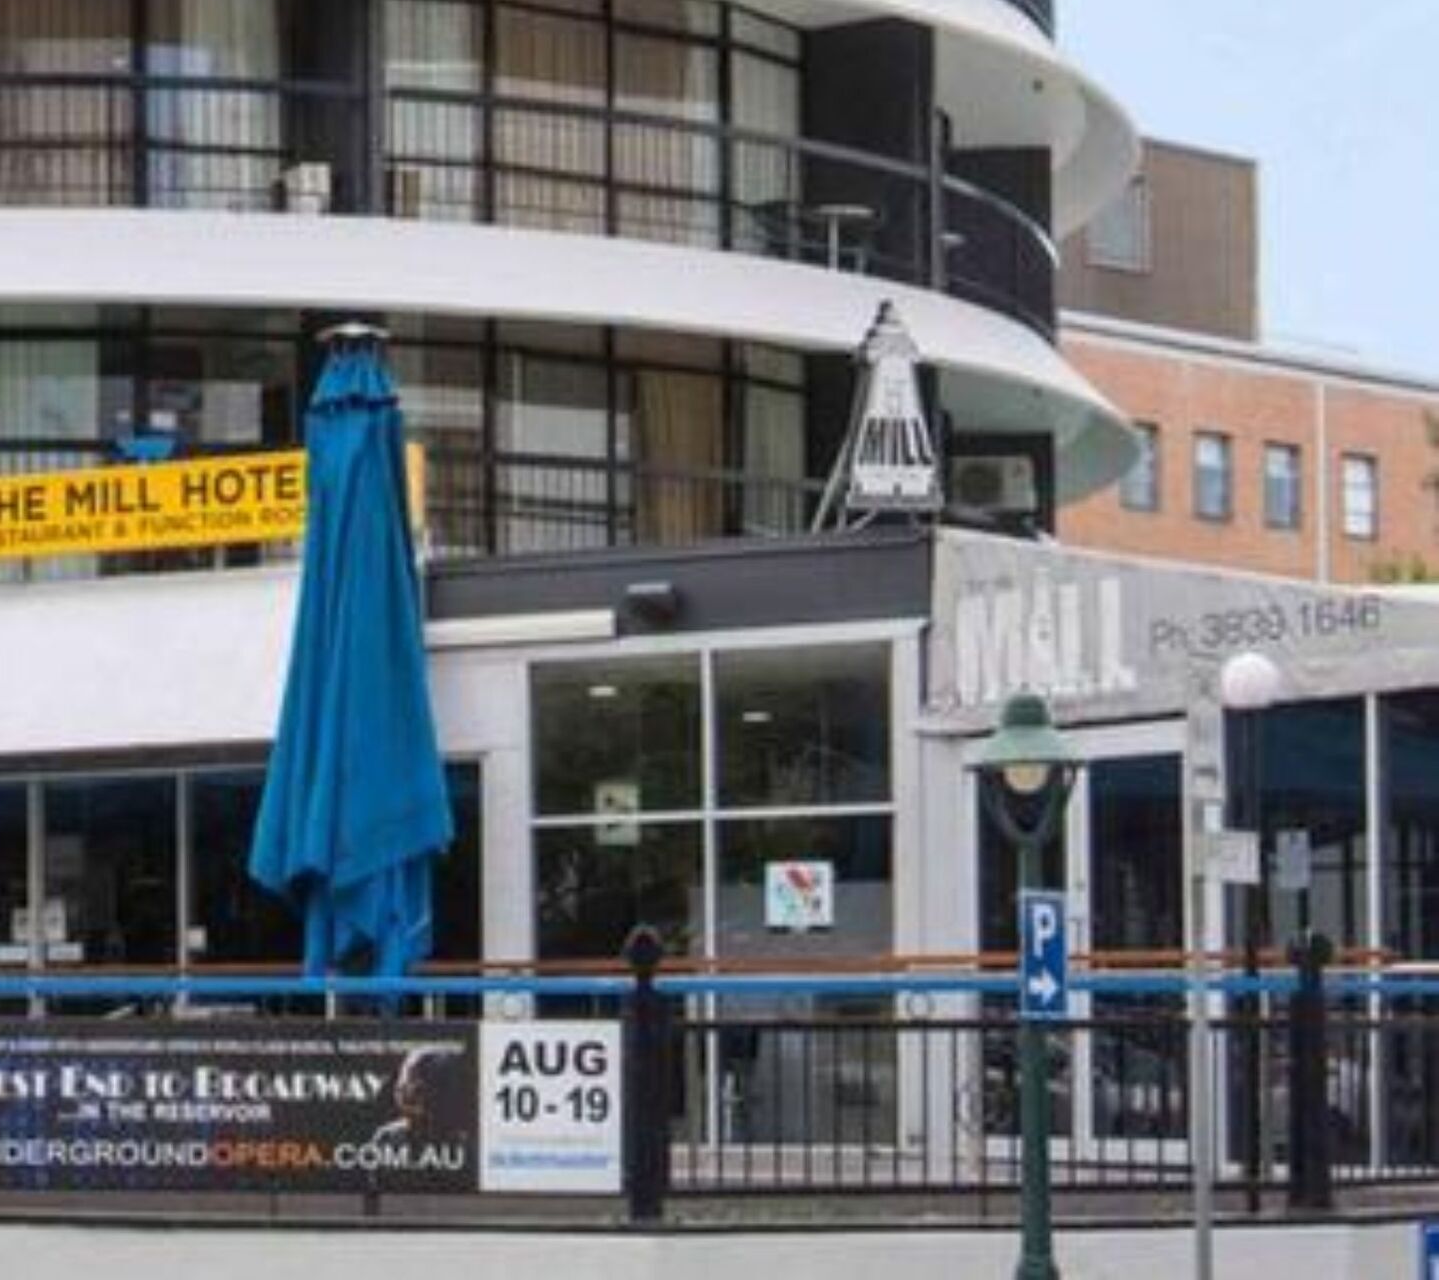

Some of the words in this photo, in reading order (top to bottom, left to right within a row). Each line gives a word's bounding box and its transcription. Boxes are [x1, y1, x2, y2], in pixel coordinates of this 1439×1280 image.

[858, 417, 934, 466] MILL
[64, 476, 161, 517] MILL
[181, 463, 301, 508] HOTE
[136, 507, 254, 536] FUNCTION
[955, 568, 1138, 706] MILL
[1298, 593, 1381, 635] 1646
[1032, 903, 1057, 958] P
[498, 1040, 608, 1076] AUG
